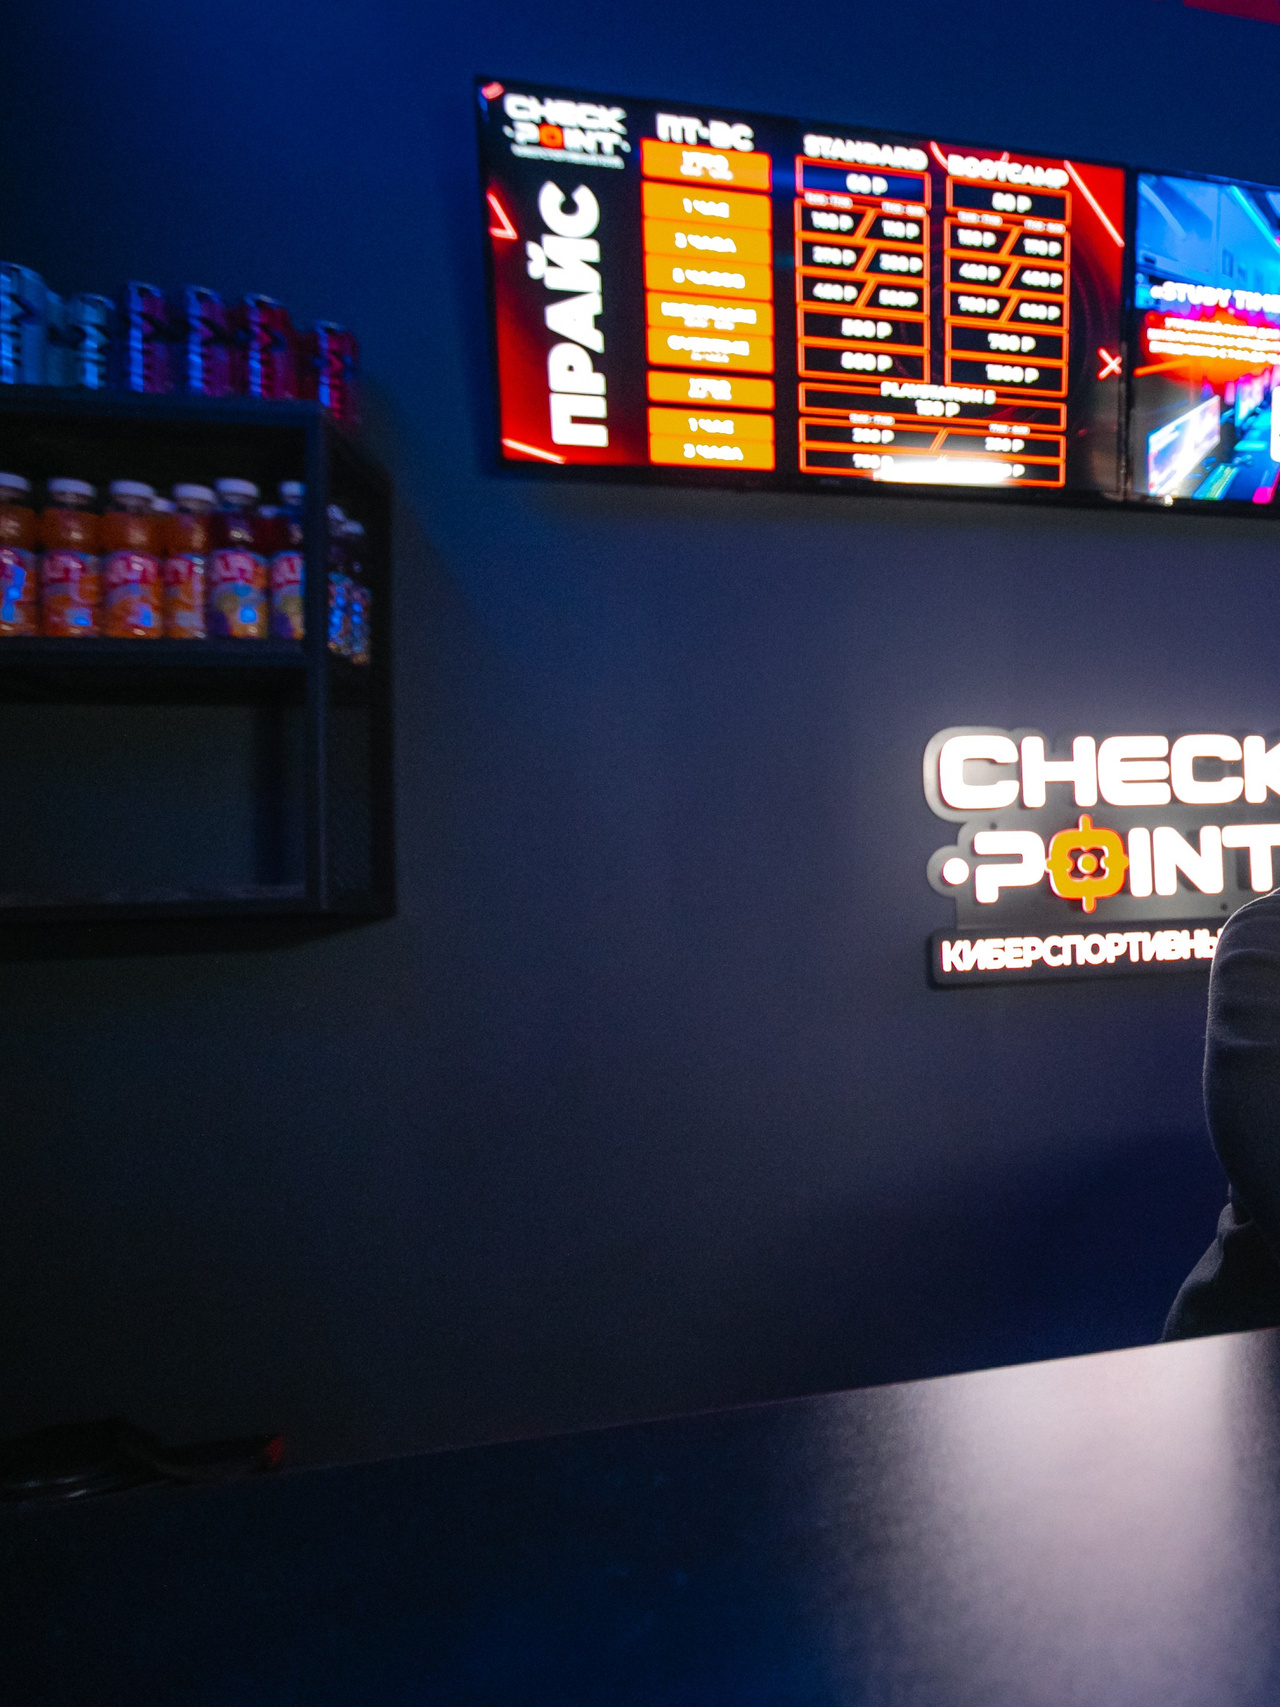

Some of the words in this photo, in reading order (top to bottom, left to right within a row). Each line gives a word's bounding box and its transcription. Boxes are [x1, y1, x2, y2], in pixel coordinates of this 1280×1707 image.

[503, 93, 629, 136] CHECK
[512, 120, 624, 157] POINT
[803, 134, 928, 171] STANDARD
[947, 153, 1069, 188] BOOTCAMP
[526, 180, 609, 447] ПРАЙС
